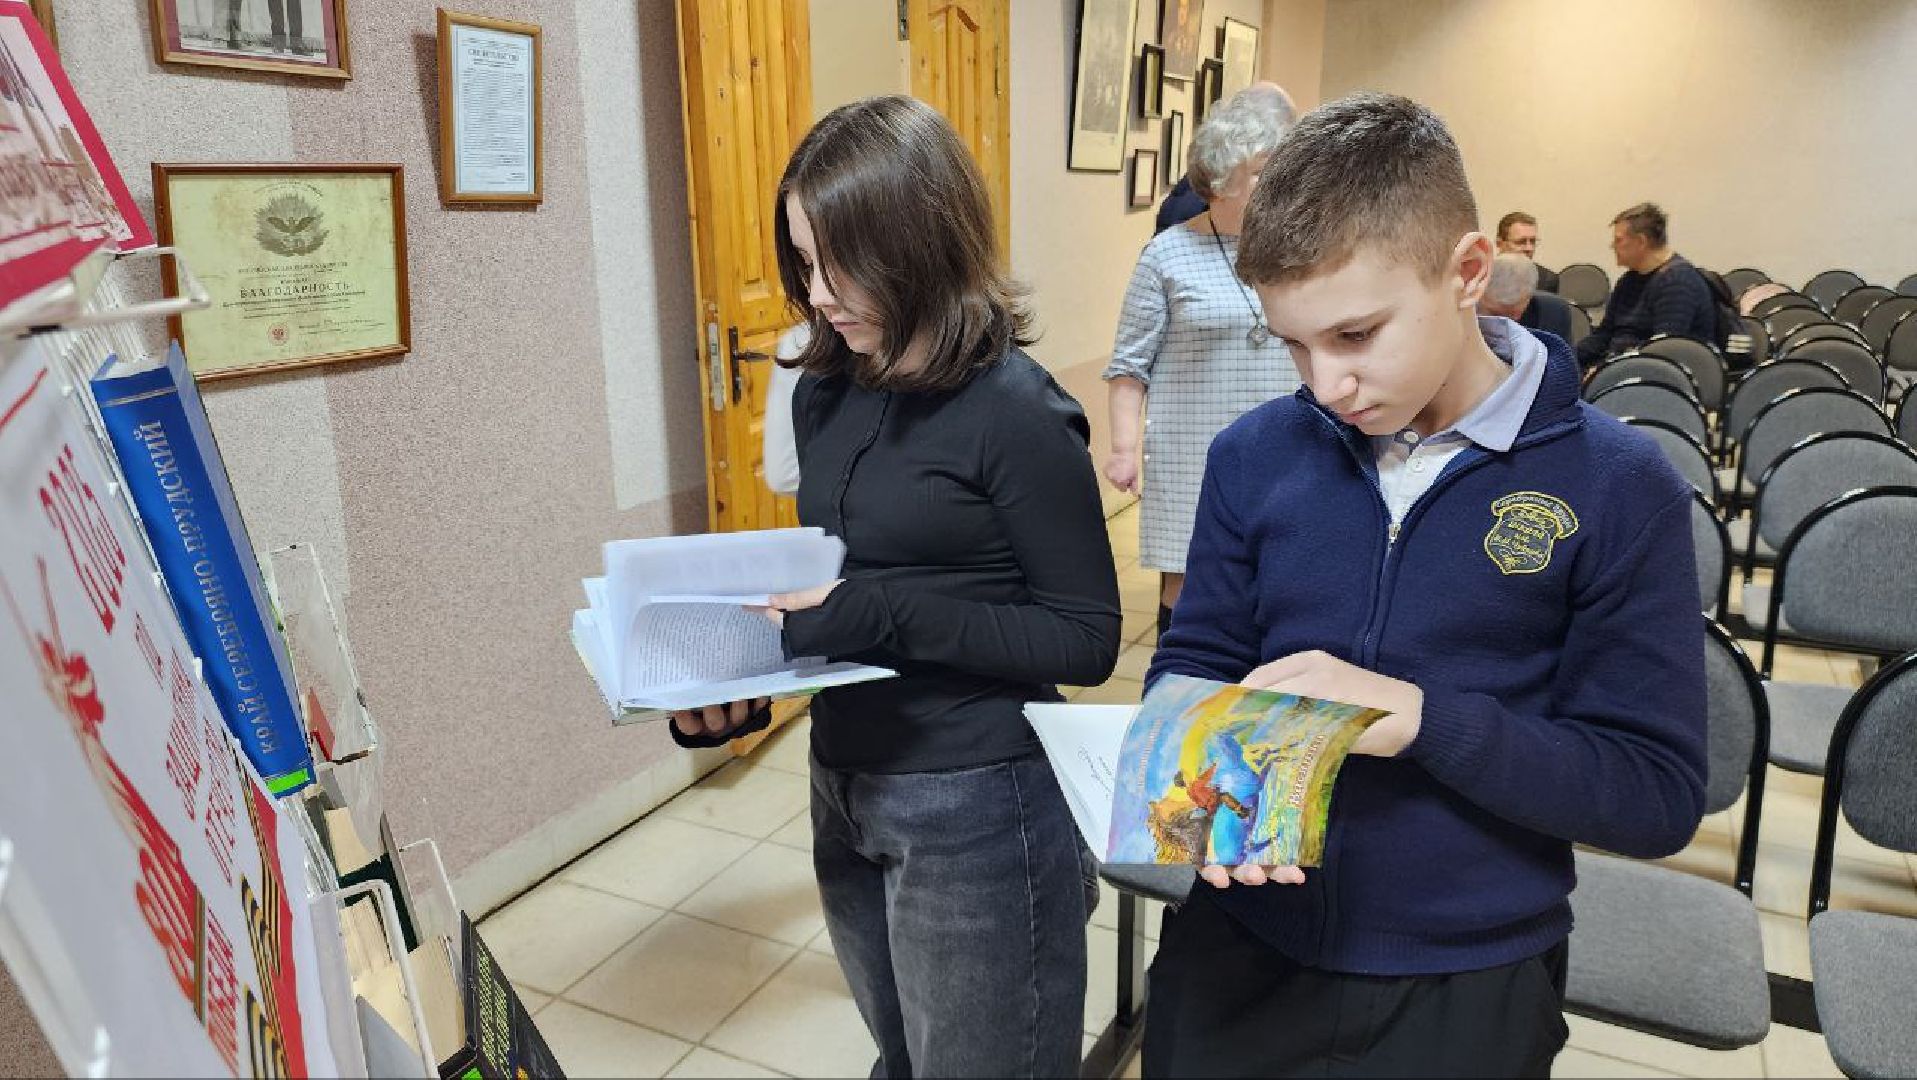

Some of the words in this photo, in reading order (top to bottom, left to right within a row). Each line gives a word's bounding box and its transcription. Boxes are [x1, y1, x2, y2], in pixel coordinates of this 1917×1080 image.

[240, 282, 351, 299] БЛАГОДАРНОСТЬ
[39, 443, 127, 637] 2025
[237, 693, 278, 755] КРАЙ
